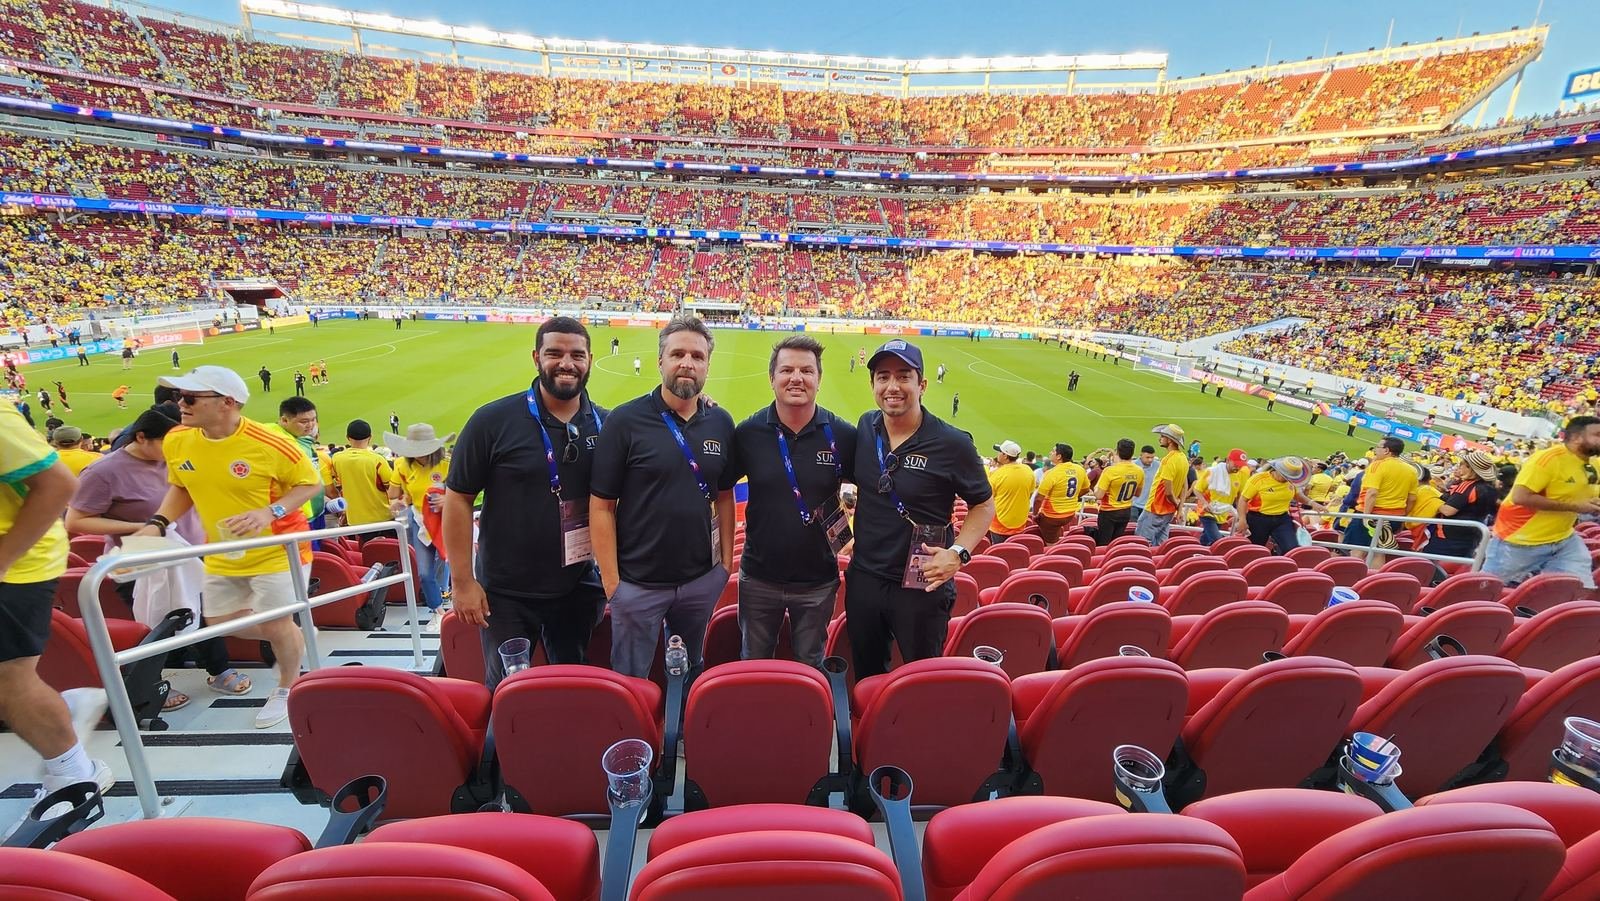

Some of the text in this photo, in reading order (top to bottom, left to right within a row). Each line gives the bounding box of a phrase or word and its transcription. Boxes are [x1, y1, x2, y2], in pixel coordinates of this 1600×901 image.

[1430, 248, 1458, 256] ULTRA
[1522, 248, 1555, 257] ULTRA
[703, 441, 721, 453] SUN
[904, 455, 928, 468] SUN
[1066, 477, 1077, 498] 8
[1117, 481, 1138, 502] 10
[159, 683, 168, 695] 29
